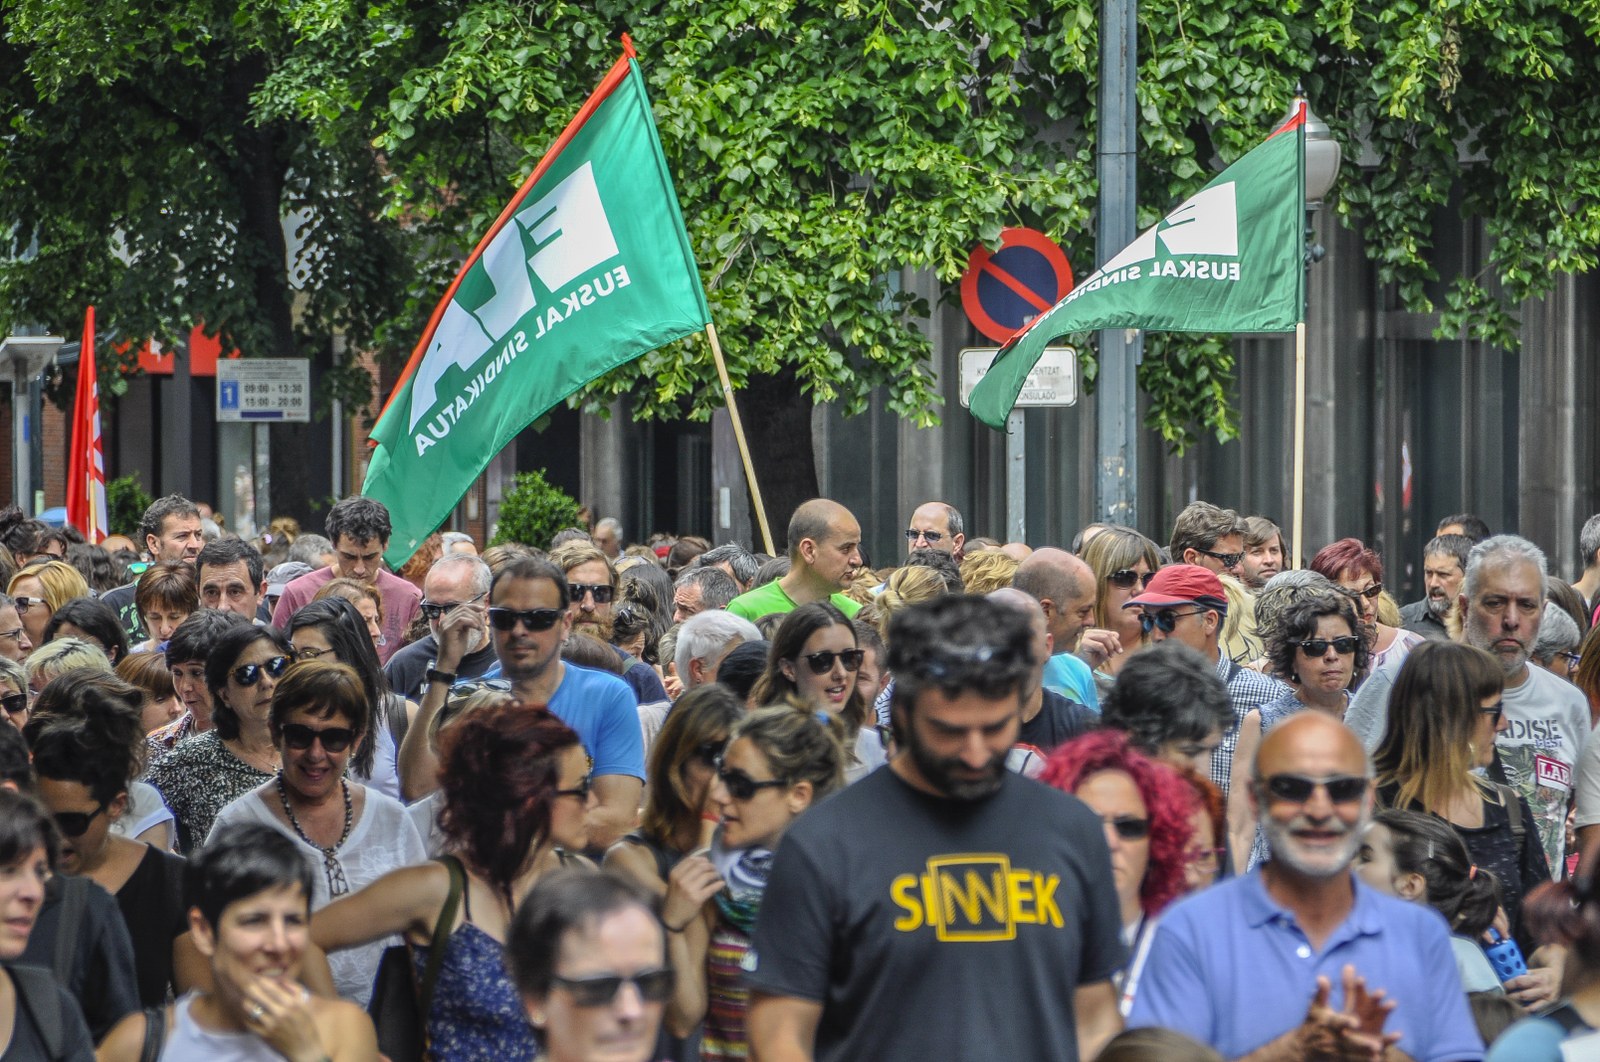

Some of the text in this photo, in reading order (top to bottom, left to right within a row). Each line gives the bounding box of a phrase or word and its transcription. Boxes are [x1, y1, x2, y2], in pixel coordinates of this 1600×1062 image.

[244, 384, 270, 394] 09:00
[278, 384, 303, 394] 13:30
[224, 387, 233, 404] 1
[1018, 391, 1057, 400] ONSULADO
[278, 397, 303, 407] 20:00
